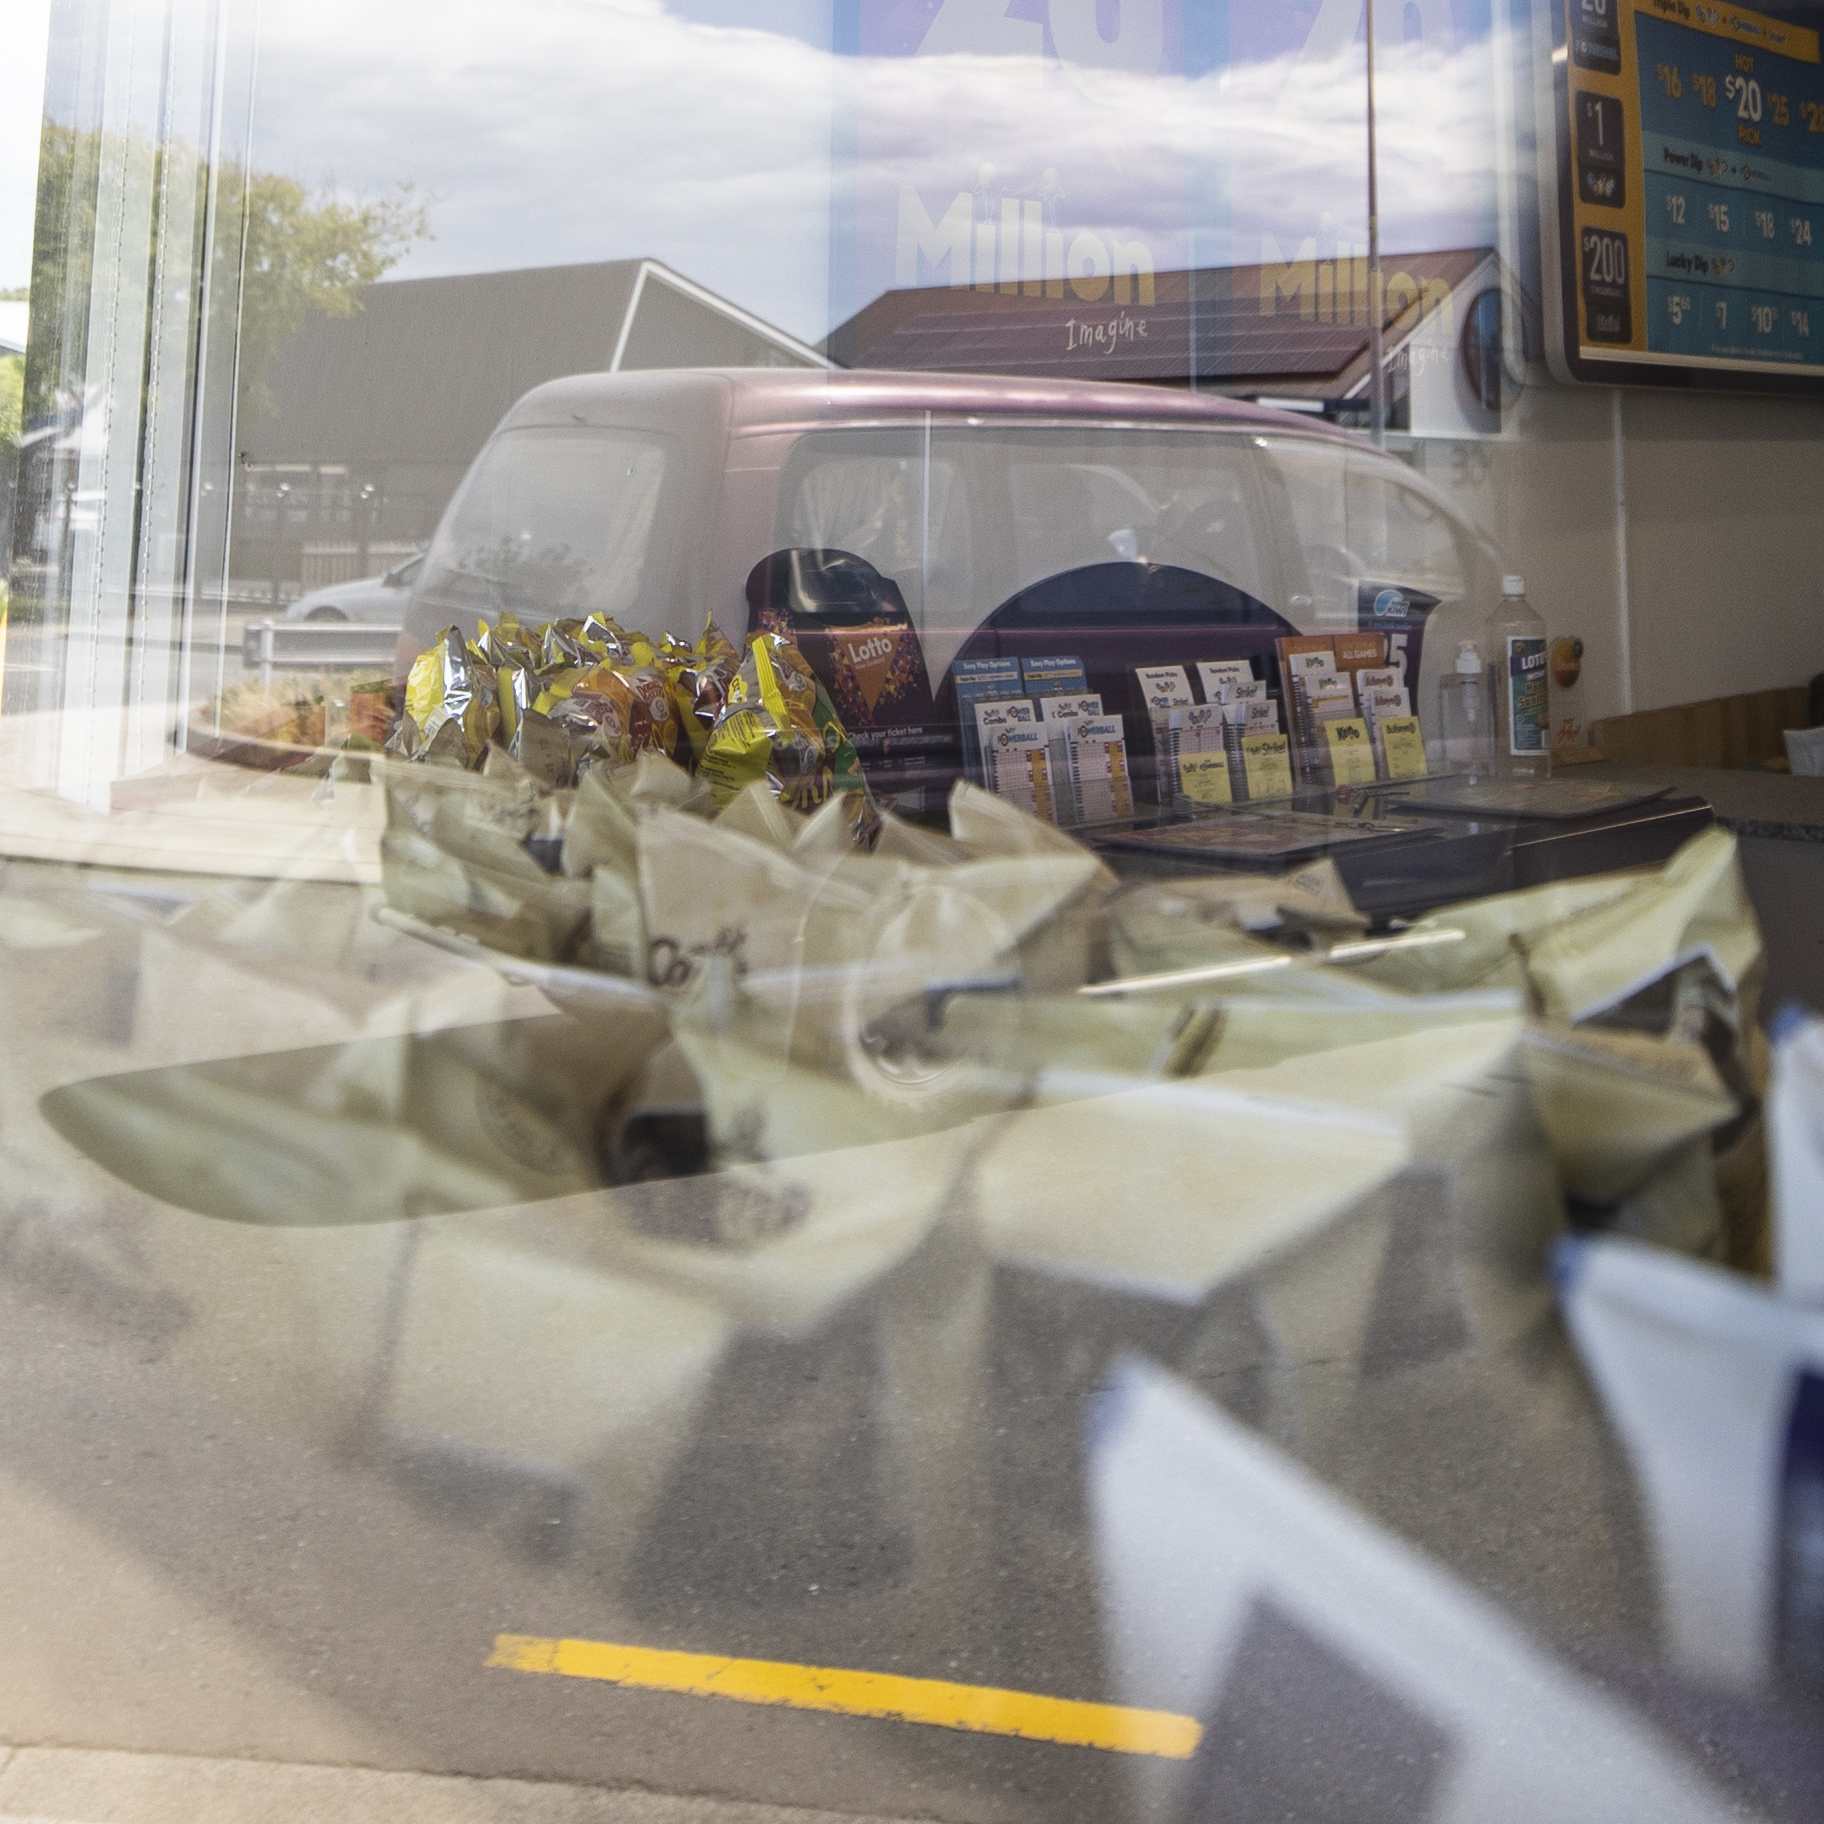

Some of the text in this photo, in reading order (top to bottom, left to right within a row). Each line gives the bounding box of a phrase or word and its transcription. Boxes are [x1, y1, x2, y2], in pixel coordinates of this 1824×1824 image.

[1734, 53, 1755, 73] HOT
[1725, 74, 1763, 122] $20
[1586, 101, 1604, 147] $1
[1663, 147, 1690, 167] Power
[1690, 153, 1704, 173] Dip
[1666, 194, 1812, 246] $12 $15 $18 $24
[896, 184, 1156, 307] Million
[1583, 234, 1625, 285] $200
[1667, 251, 1692, 274] Lucky
[1694, 254, 1709, 275] Dip
[1259, 231, 1453, 331] Million
[1716, 301, 1728, 330] $7
[1790, 311, 1810, 336] $14
[1065, 310, 1148, 353] Imagine
[847, 637, 893, 664] Lotto
[1031, 657, 1076, 668] Easy Play Options
[1342, 648, 1378, 659] ALL GAMES
[963, 660, 1011, 670] Easy Play Options
[1236, 686, 1258, 699] Strike!
[848, 726, 923, 741] Check your ticket here
[997, 733, 1038, 746] POWERBALL
[1078, 725, 1116, 738] POWERBALL
[1336, 726, 1360, 741] Keno
